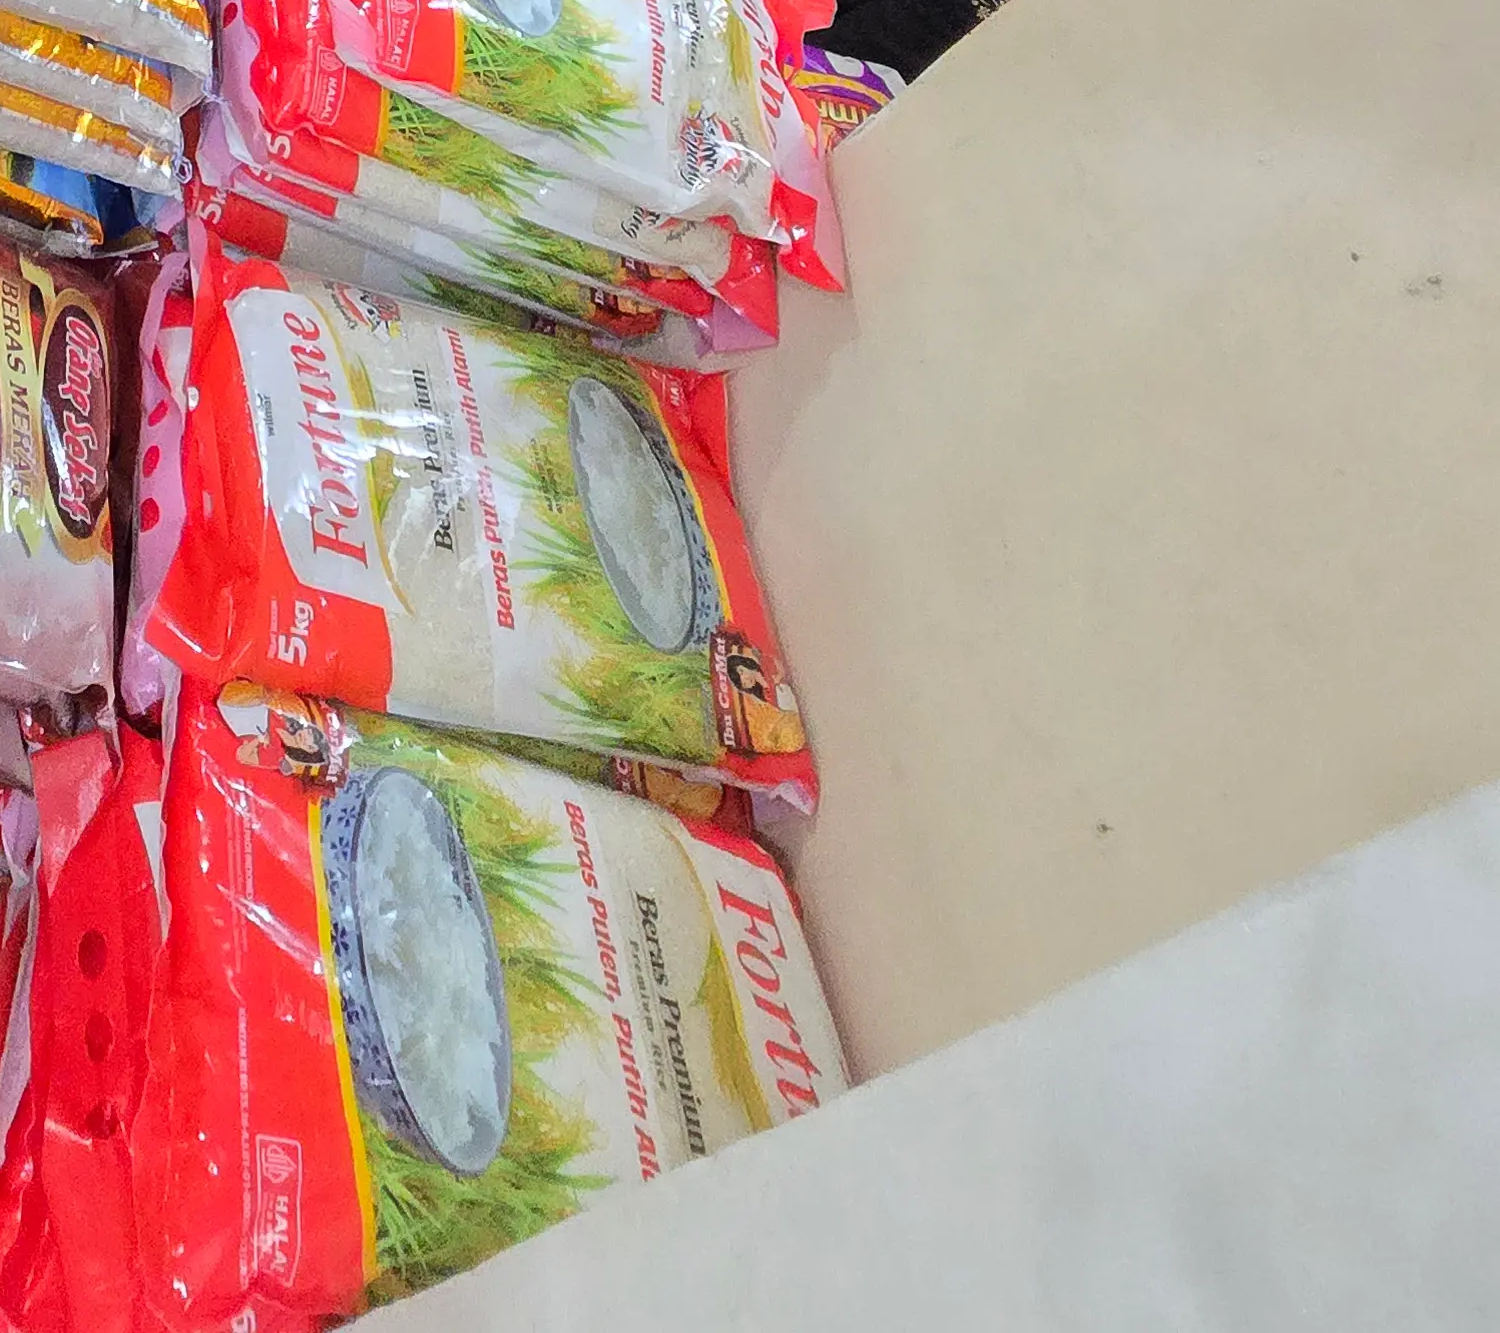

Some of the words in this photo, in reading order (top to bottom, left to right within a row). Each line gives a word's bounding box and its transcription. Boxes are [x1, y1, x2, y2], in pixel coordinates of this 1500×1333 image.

[647, 33, 667, 107] Alami
[1, 277, 28, 380] BERAS
[441, 326, 475, 393] Alami
[282, 311, 369, 570] Fortune
[460, 394, 489, 460] Putih
[488, 549, 516, 632] Beras
[279, 598, 315, 667] 5kg
[563, 799, 599, 890] Beras
[586, 894, 622, 1003] Pulen,
[611, 1012, 648, 1121] Putih
[636, 891, 669, 989] Beras
[658, 995, 706, 1156] Premium
